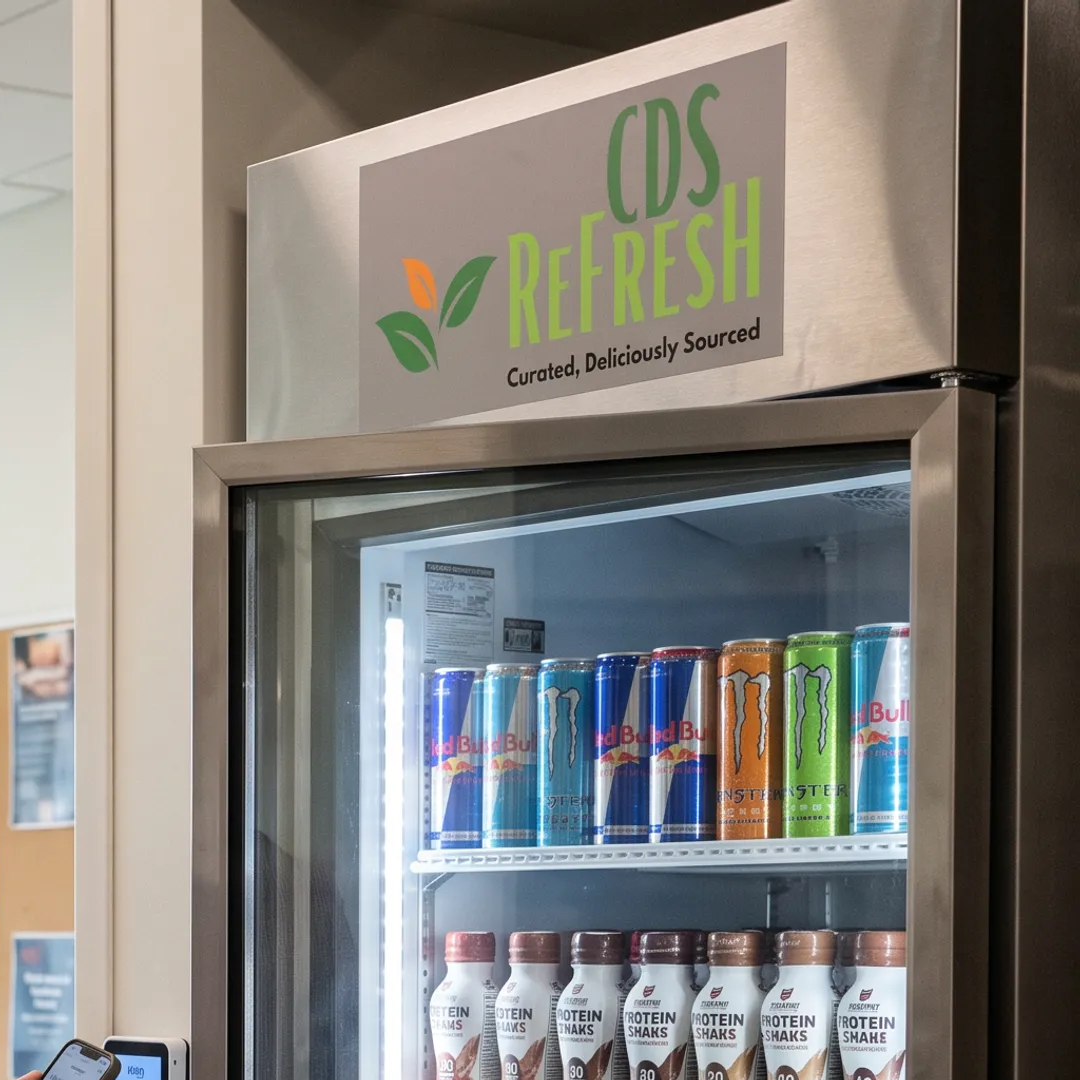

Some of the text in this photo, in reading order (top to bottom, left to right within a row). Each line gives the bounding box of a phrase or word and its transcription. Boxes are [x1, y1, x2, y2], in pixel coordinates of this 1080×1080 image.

[607, 82, 721, 224] CDS
[506, 316, 761, 388] Curated, Deliciously Sourced
[869, 698, 911, 723] Bull
[628, 1026, 668, 1039] SHAKS
[765, 1030, 809, 1043] SHAKS
